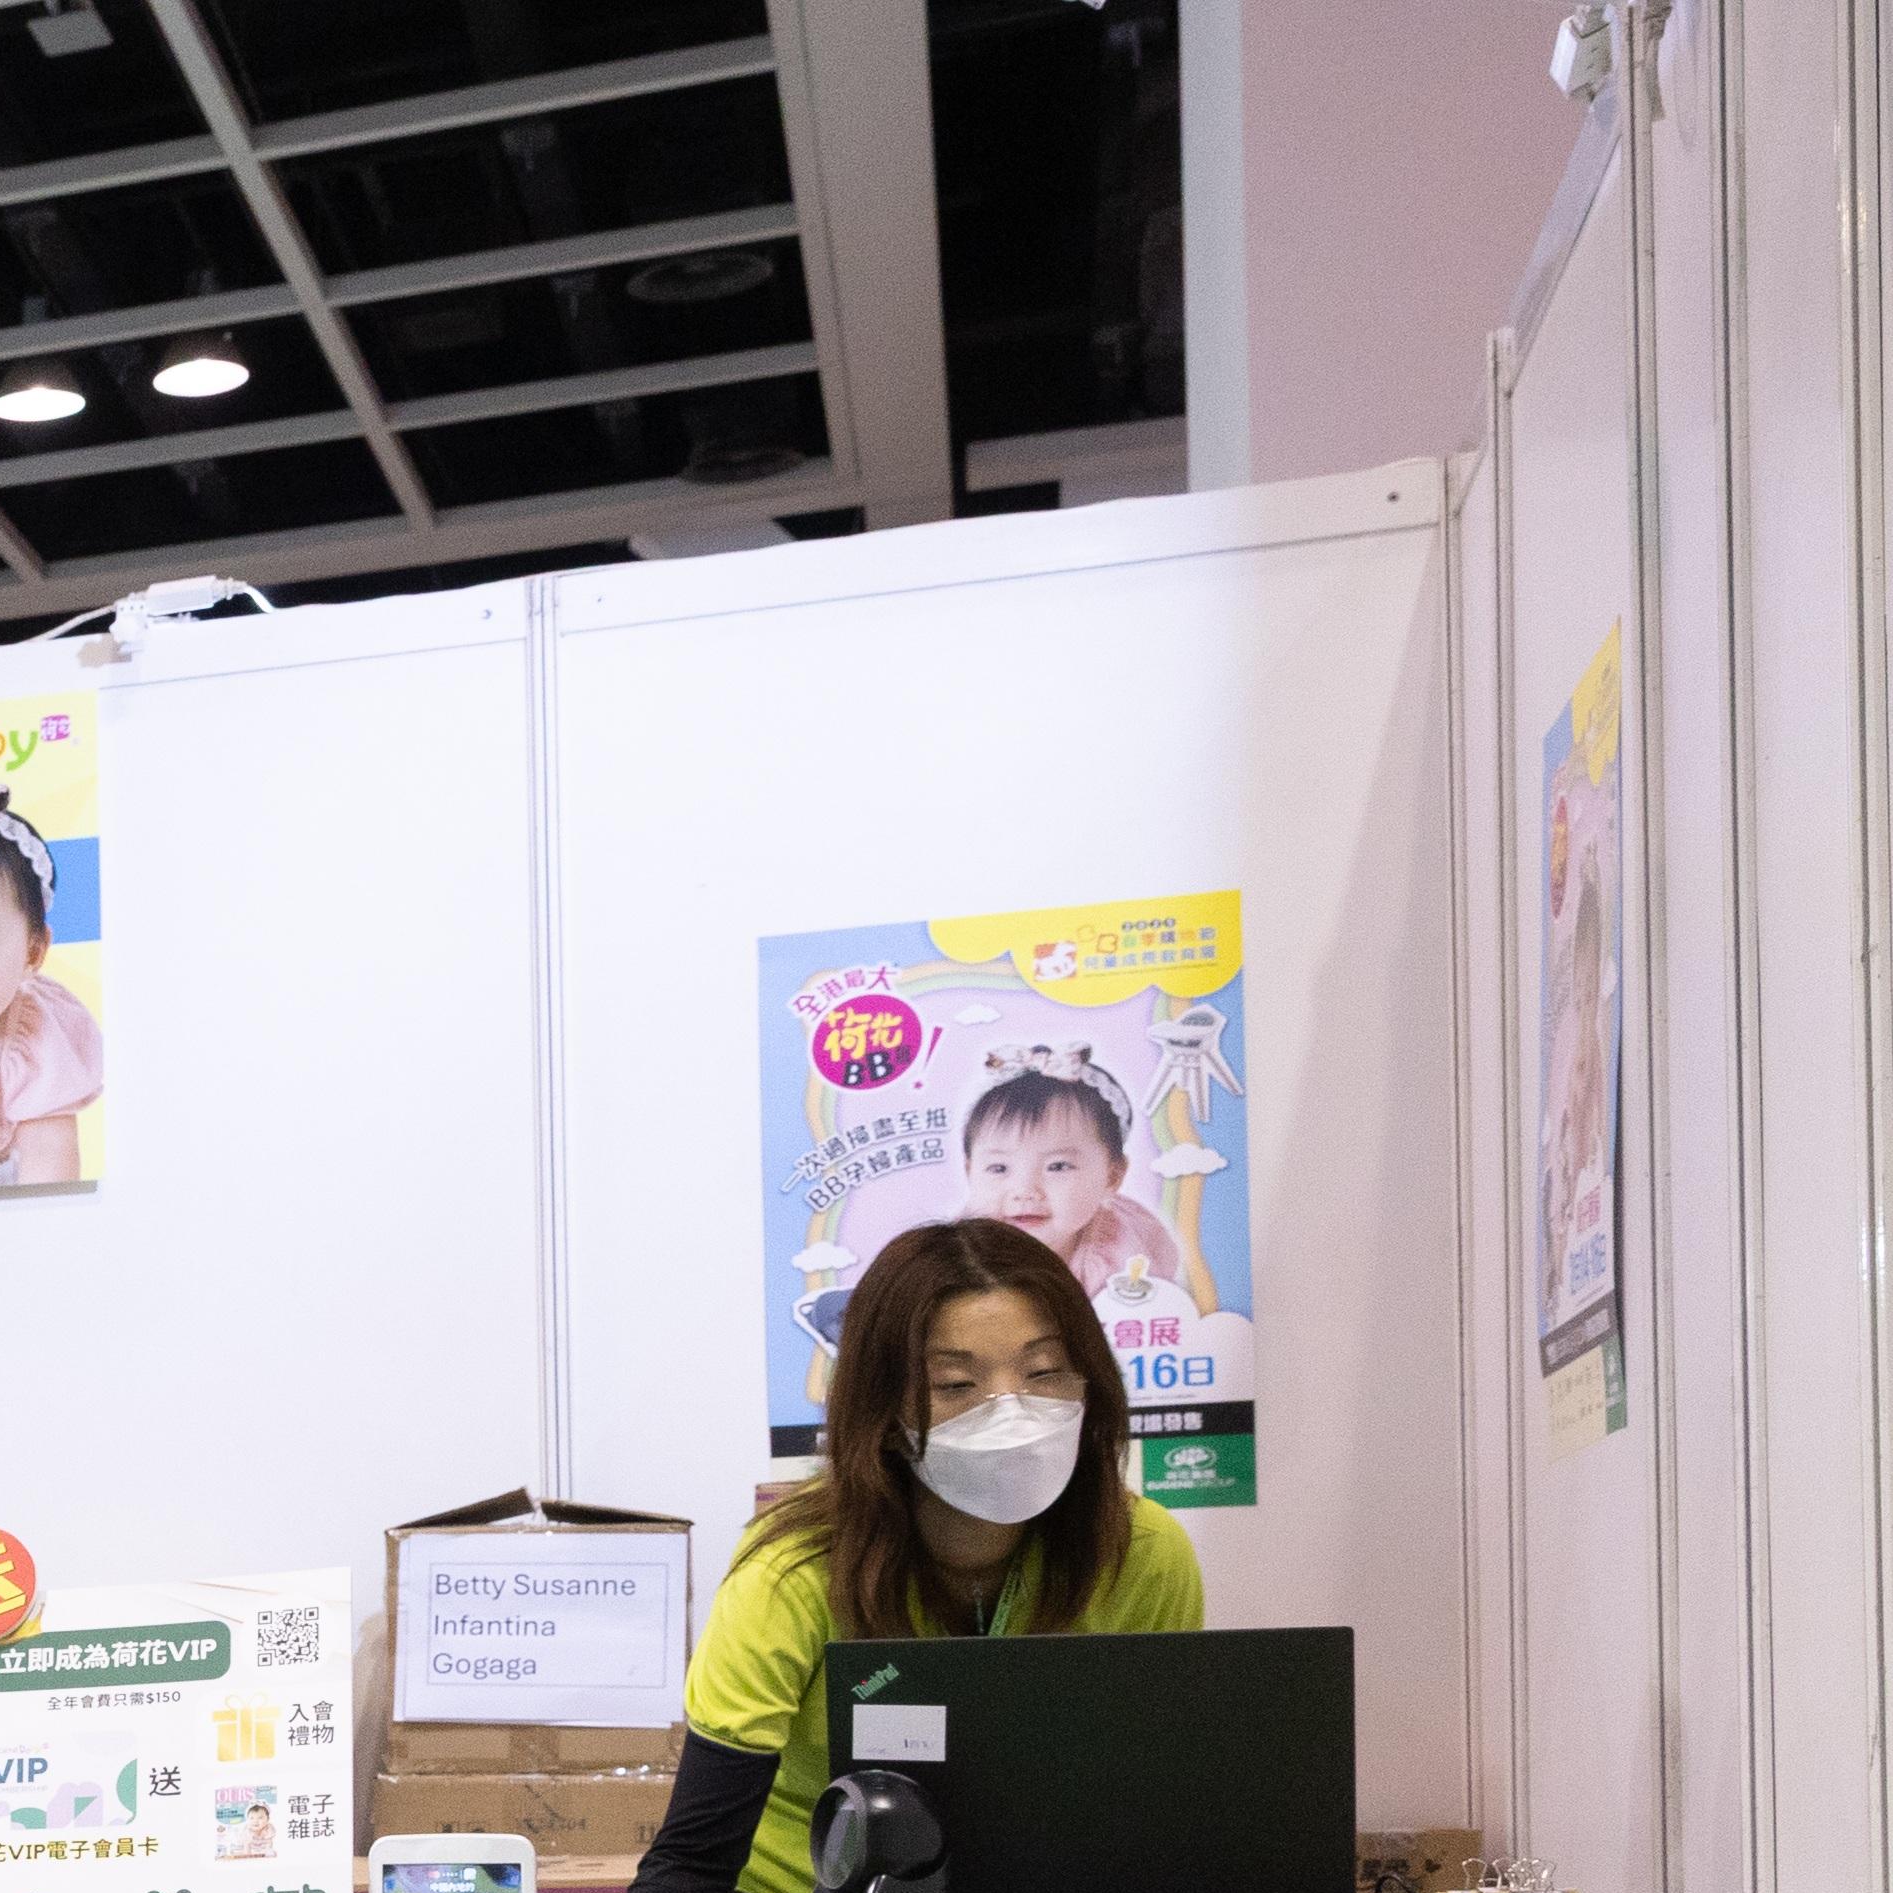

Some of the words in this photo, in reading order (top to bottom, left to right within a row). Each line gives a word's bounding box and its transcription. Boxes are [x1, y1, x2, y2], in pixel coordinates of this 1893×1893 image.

[435, 1573, 506, 1600] Betty
[513, 1573, 637, 1598] Susanne
[434, 1614, 556, 1638] Infantina
[0, 1638, 217, 1675] 立即成為荷花VIP
[433, 1653, 538, 1681] Gogaga
[851, 1662, 900, 1700] ThinkPad
[289, 1701, 333, 1722] 入會
[289, 1724, 334, 1746] 禮物
[149, 1765, 182, 1797] 送
[288, 1794, 334, 1815] 電子
[288, 1816, 335, 1840] 雜誌
